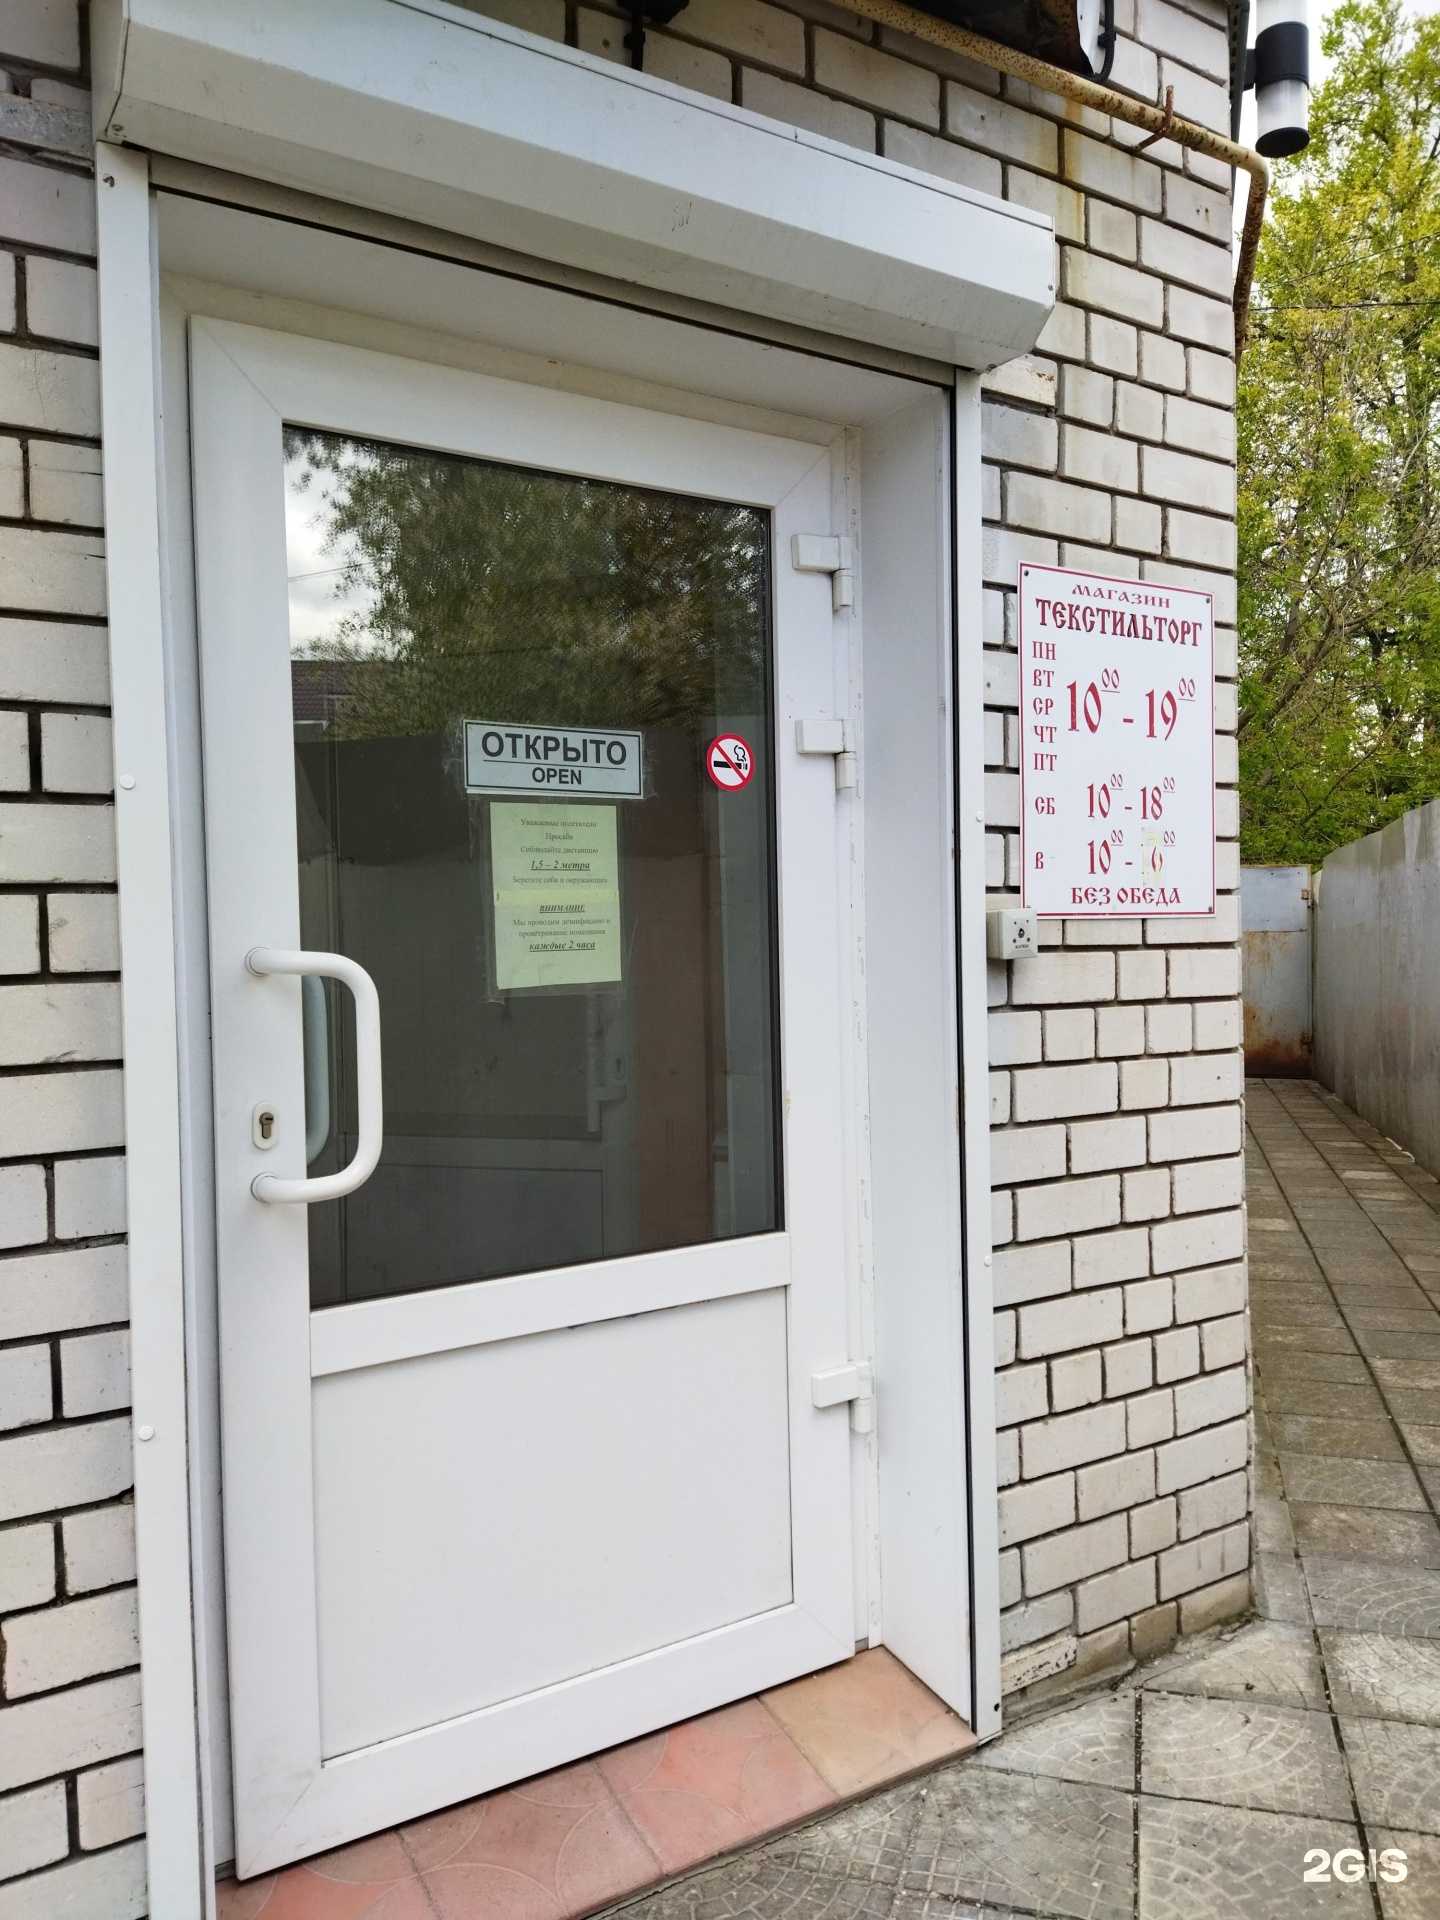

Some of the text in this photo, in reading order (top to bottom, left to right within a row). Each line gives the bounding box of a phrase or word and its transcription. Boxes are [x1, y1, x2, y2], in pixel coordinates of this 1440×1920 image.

[1035, 598, 1202, 647] ТЕКСТИЛЬТОРГ
[1032, 641, 1056, 660] ПН
[1033, 669, 1055, 688] ВТ
[1033, 697, 1054, 715] СР
[1034, 725, 1057, 743] ЧТ
[481, 731, 627, 765] ОТКРЫТО
[1034, 753, 1057, 772] ПТ
[531, 767, 582, 785] OPEN
[1034, 796, 1056, 815] СБ
[553, 860, 559, 869] 2
[560, 861, 590, 871] метра
[1071, 887, 1181, 907] БЕЗ ОБЕДА
[529, 940, 596, 951] каждые 2 часа
